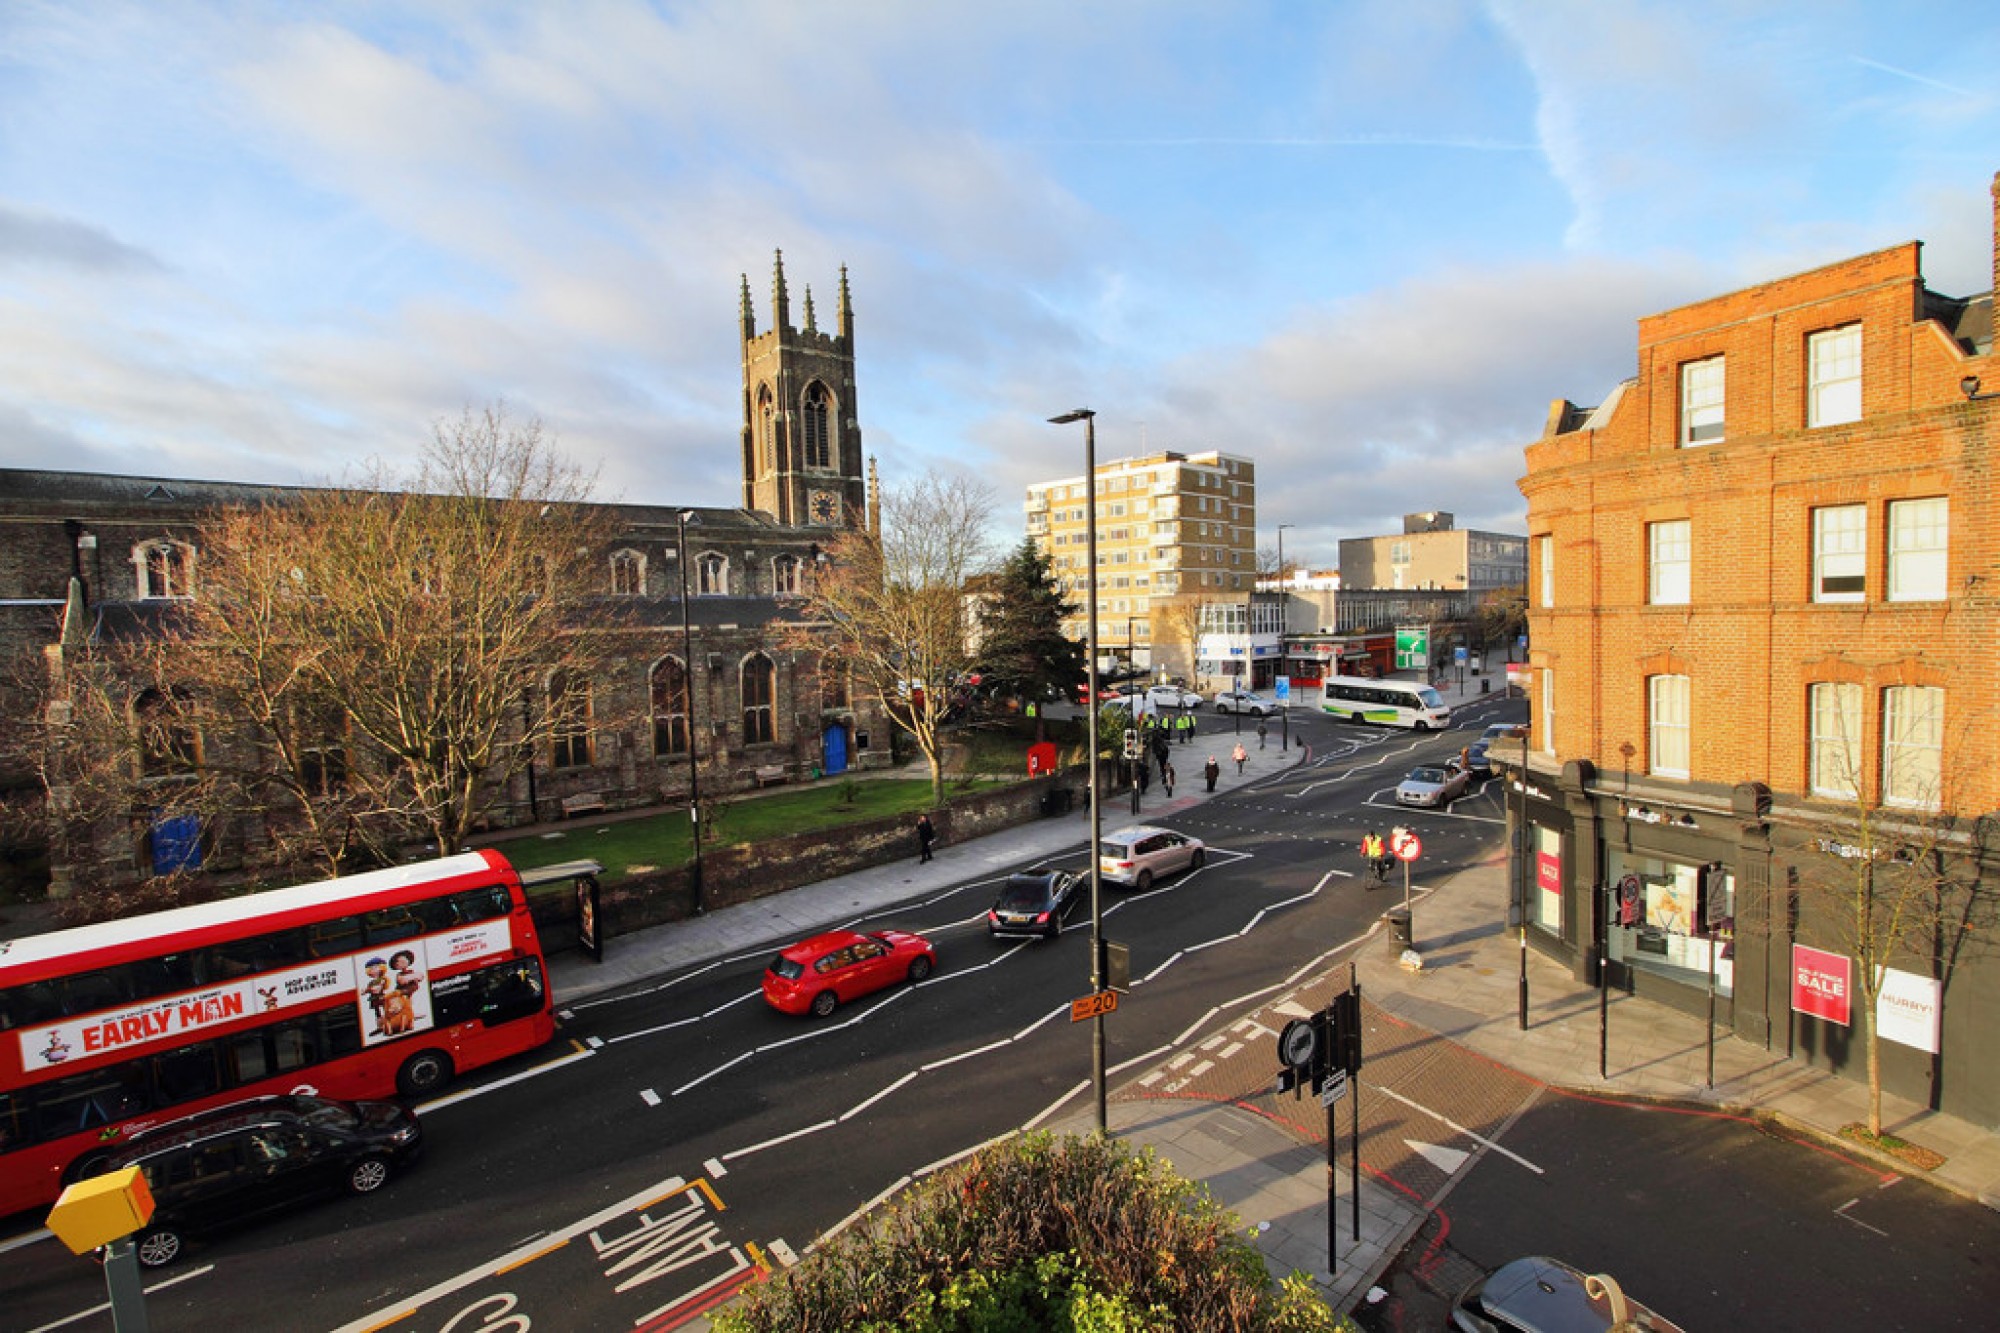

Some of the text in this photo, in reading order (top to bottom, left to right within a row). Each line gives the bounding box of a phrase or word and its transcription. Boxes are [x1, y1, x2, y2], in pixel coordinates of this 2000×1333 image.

[285, 977, 303, 988] HOP
[305, 974, 318, 982] ON
[286, 977, 337, 995] ADVENTURE
[1797, 973, 1845, 997] SALE
[1093, 993, 1114, 1012] 20
[1882, 992, 1933, 1015] HURRY!
[82, 1008, 172, 1052] EARLY
[179, 991, 243, 1028] MAN
[588, 1188, 751, 1326] LANE
